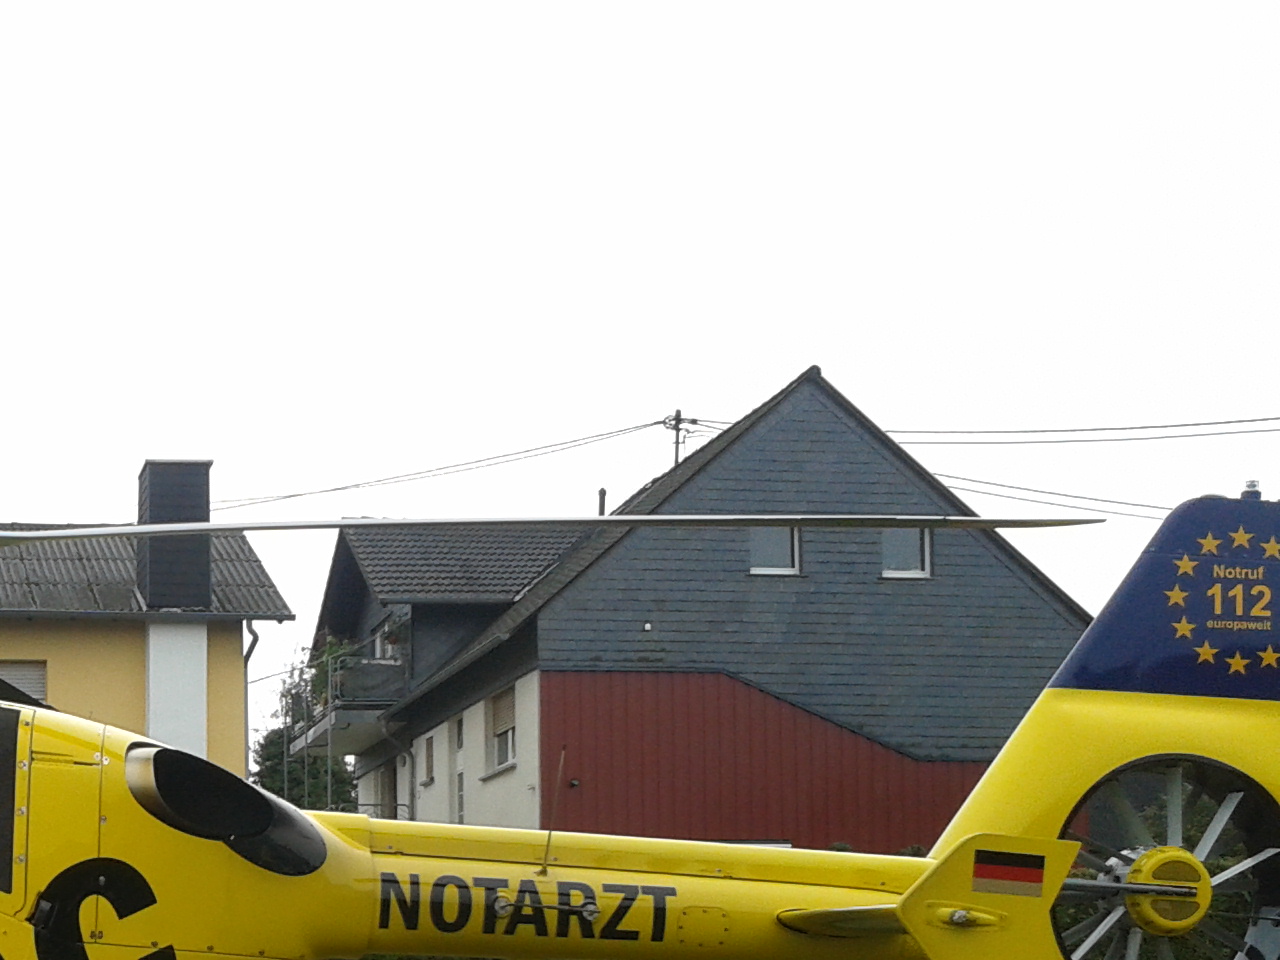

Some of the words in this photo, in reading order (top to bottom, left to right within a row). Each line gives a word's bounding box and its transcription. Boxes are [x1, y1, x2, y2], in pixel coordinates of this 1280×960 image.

[1213, 564, 1264, 579] Notruf
[1206, 583, 1271, 616] 112
[1206, 619, 1272, 632] europaweit
[378, 871, 677, 942] NOTARZT
